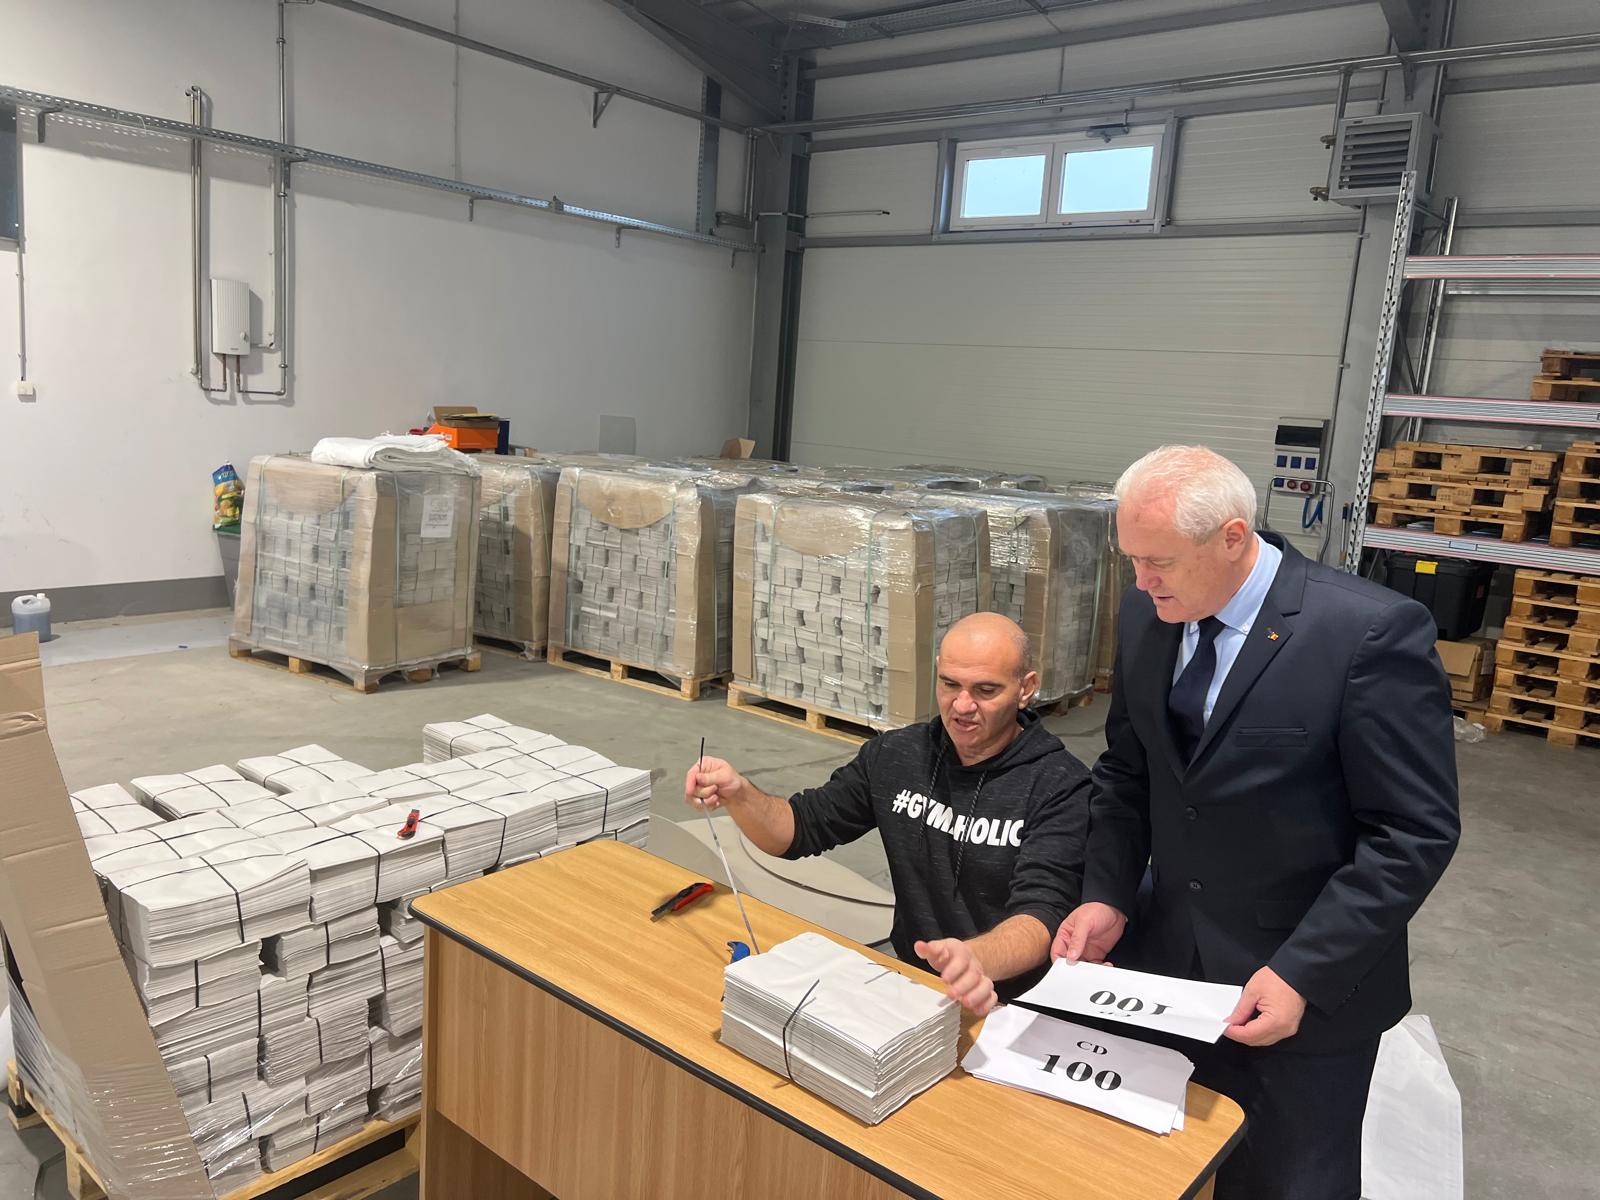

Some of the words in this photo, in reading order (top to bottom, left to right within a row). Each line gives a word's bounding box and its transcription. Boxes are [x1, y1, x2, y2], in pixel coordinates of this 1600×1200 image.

[891, 788, 1025, 848] #GYMHOLIC
[1076, 1040, 1108, 1055] CD
[1039, 1053, 1122, 1091] 100
